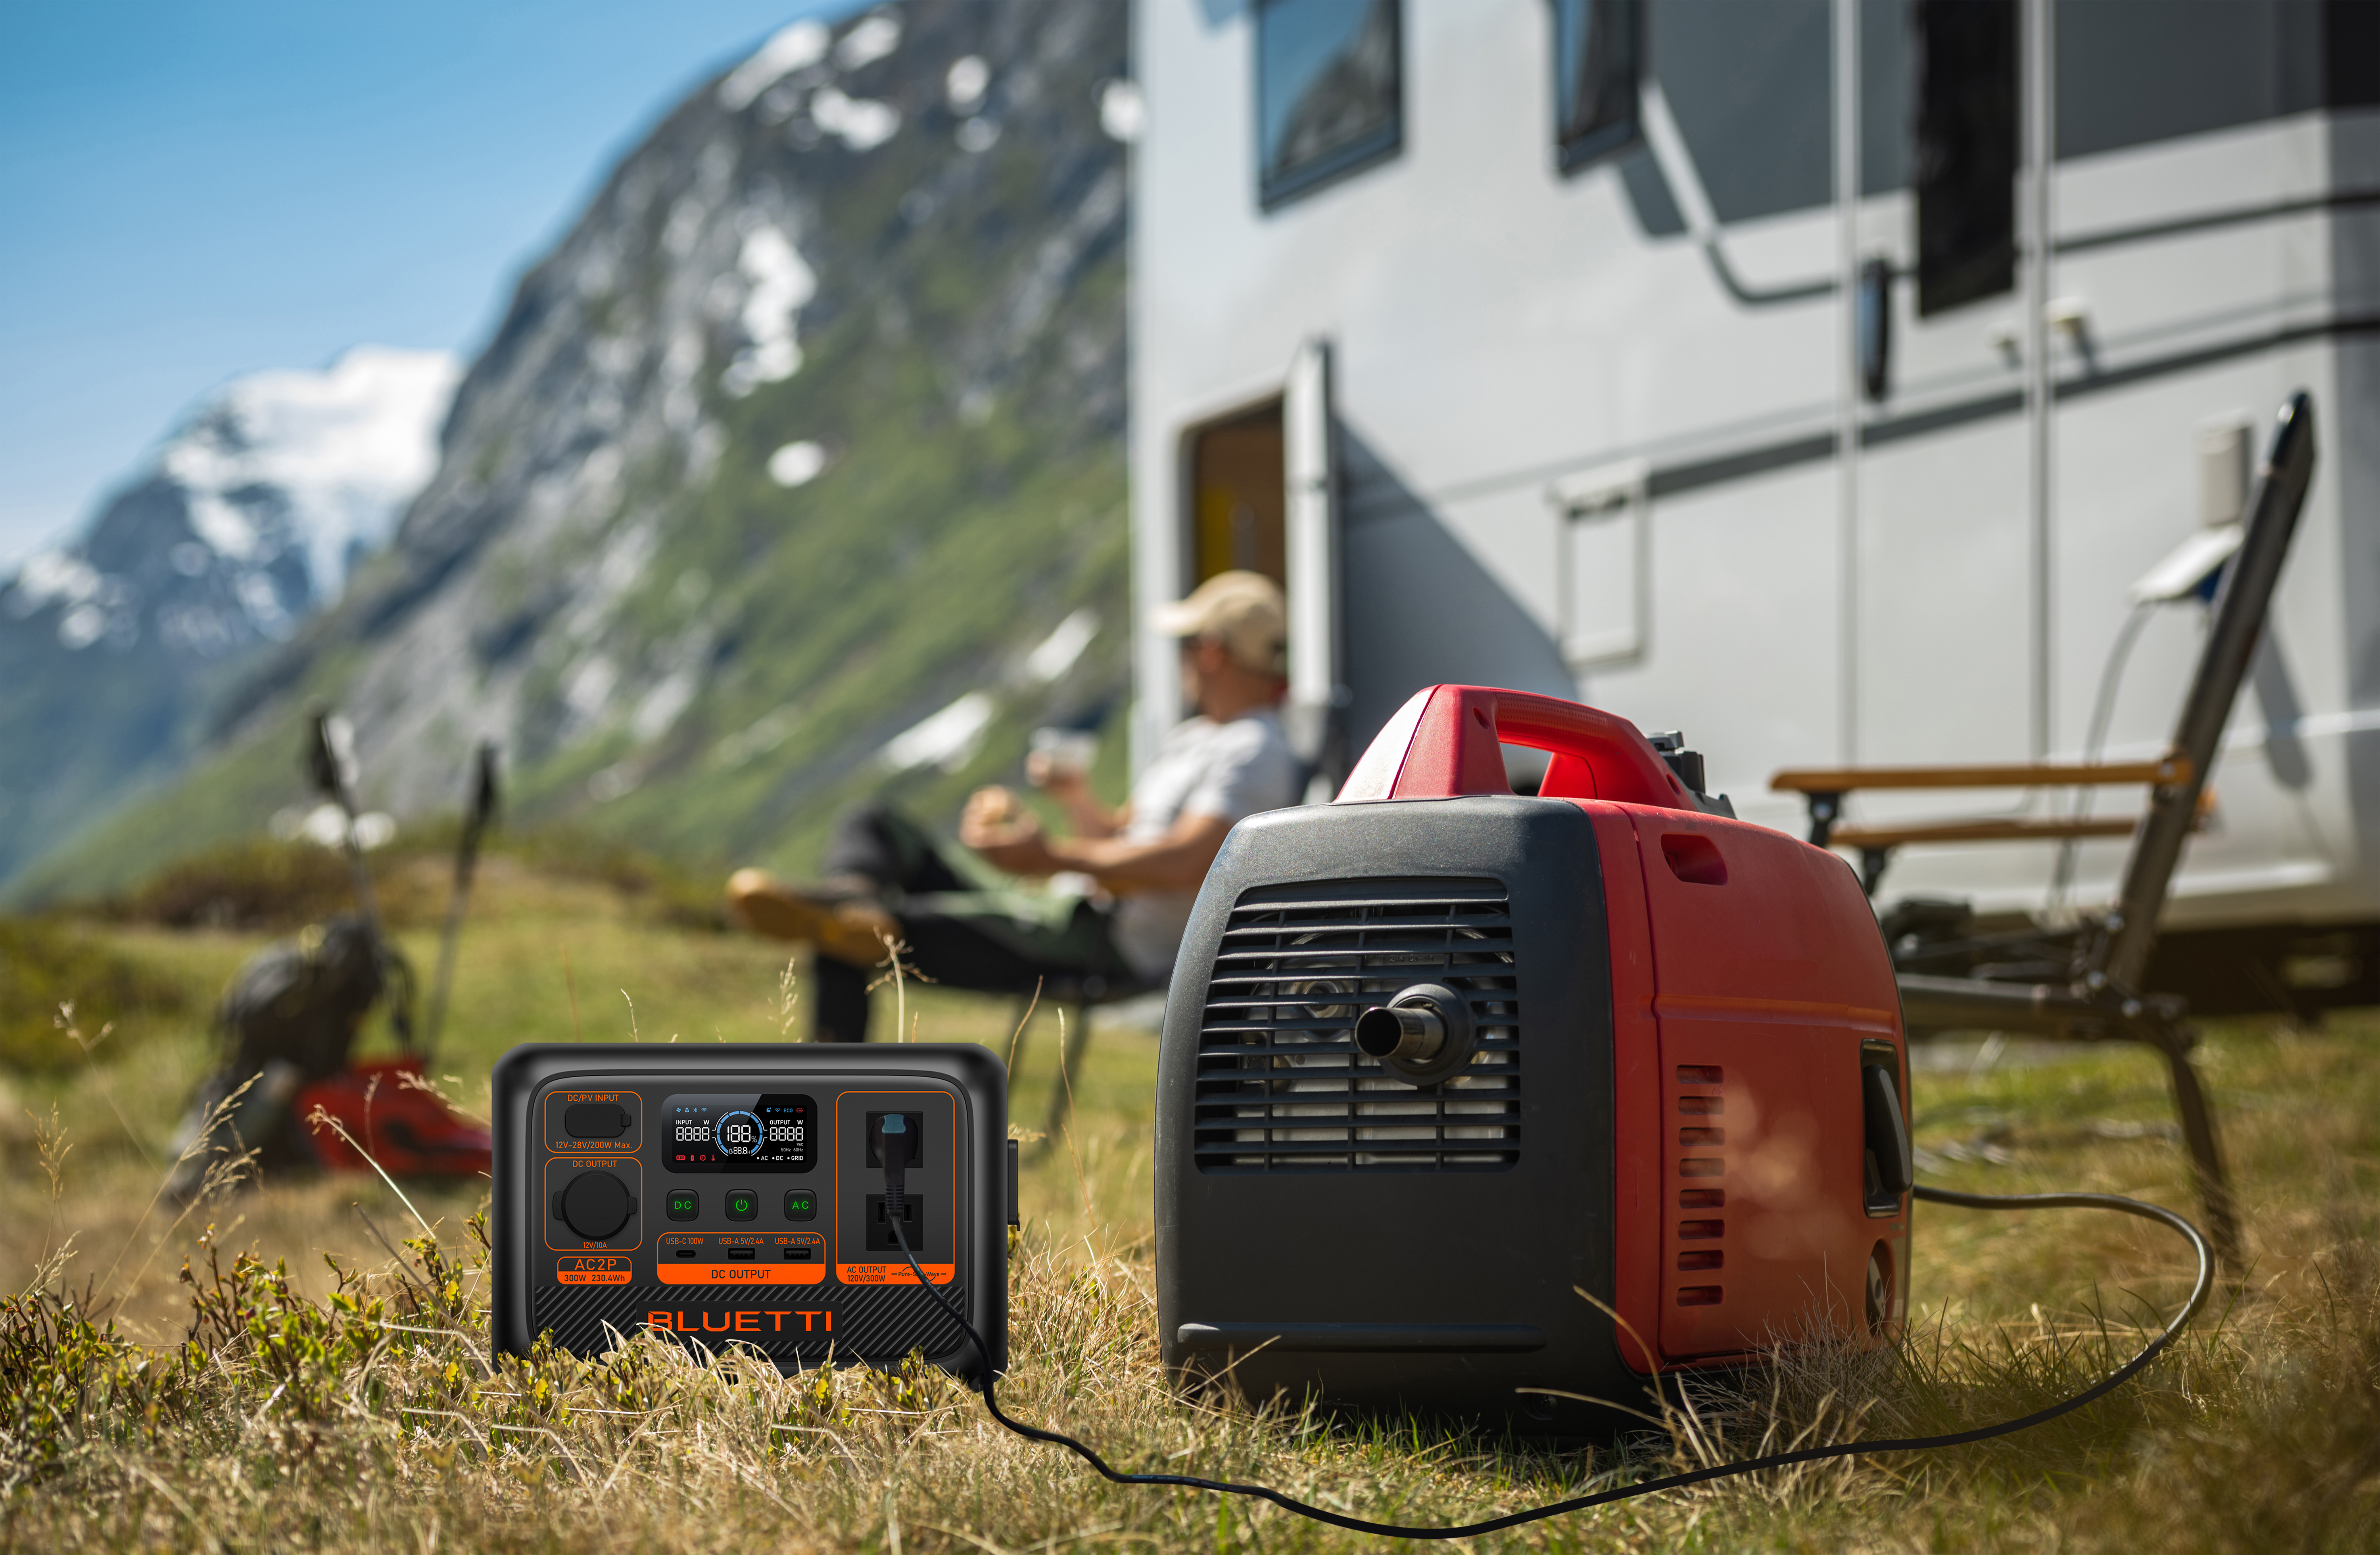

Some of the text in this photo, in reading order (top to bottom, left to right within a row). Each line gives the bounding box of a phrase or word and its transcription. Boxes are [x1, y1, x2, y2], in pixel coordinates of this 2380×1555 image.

[568, 1094, 593, 1102] DC/PV
[676, 1127, 710, 1141] 8888
[770, 1127, 803, 1141] 8888
[556, 1141, 612, 1149] 12V-28V/200W
[741, 1237, 764, 1246] 5V/2.4A
[797, 1237, 820, 1246] 5V/2.4A
[574, 1259, 617, 1270] AC2P
[712, 1270, 771, 1278] DC OUTPUT
[847, 1274, 885, 1283] 120V/300W
[648, 1311, 831, 1332] BLUETTI
